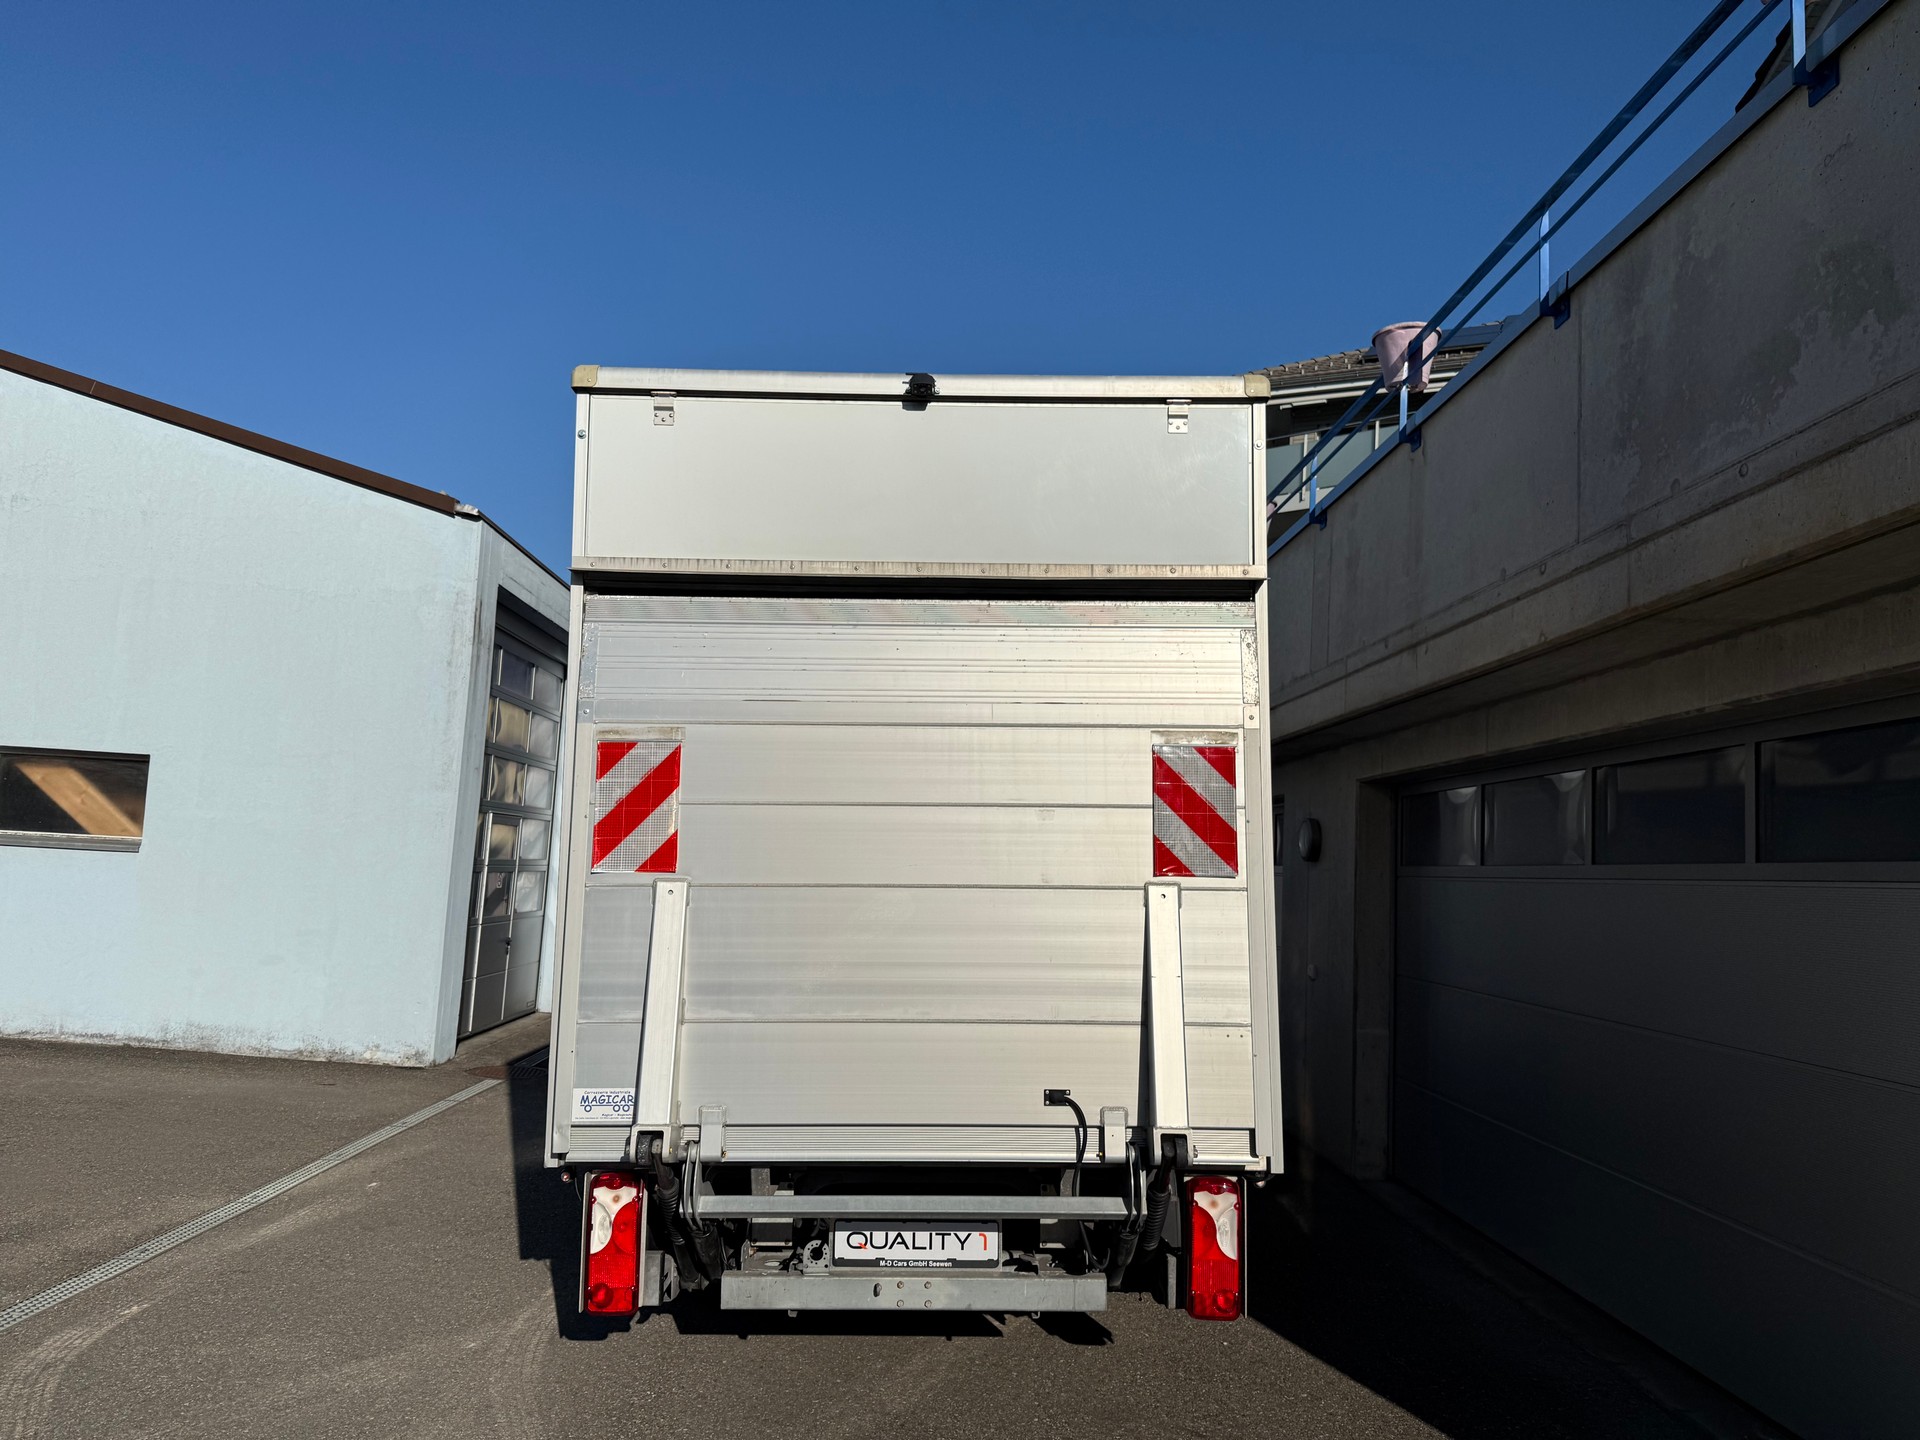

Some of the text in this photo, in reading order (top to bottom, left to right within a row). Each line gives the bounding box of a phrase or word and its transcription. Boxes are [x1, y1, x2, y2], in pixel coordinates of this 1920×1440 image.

[580, 1094, 634, 1104] MAGICAR
[846, 1231, 987, 1250] QUALITY 1
